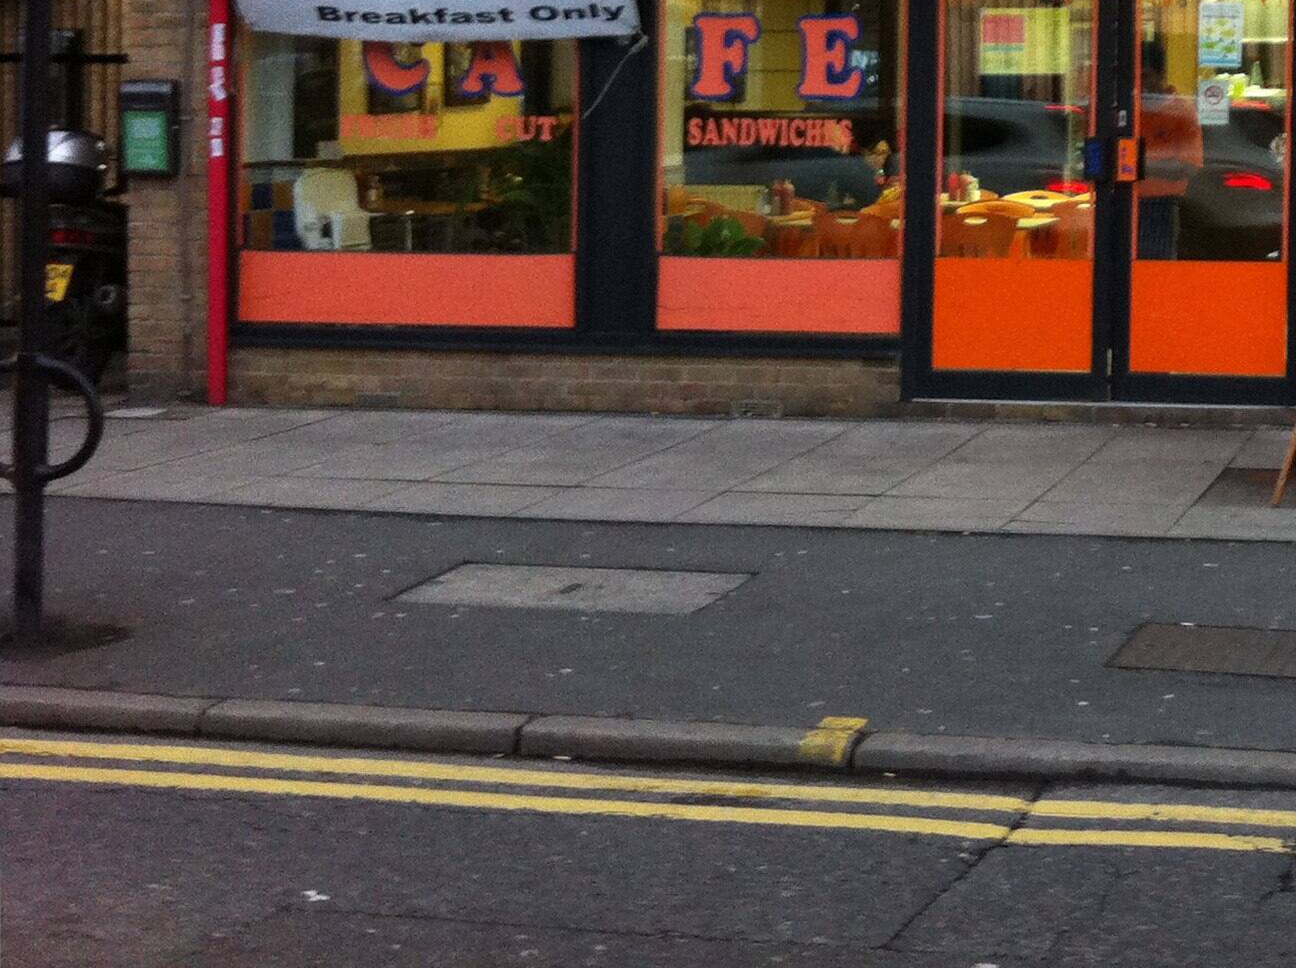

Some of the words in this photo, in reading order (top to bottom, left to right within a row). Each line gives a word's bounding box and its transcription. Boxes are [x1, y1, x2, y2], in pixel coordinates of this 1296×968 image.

[316, 5, 516, 26] Breakfast
[528, 3, 626, 23] Only
[687, 116, 854, 148] SANDWICHES
